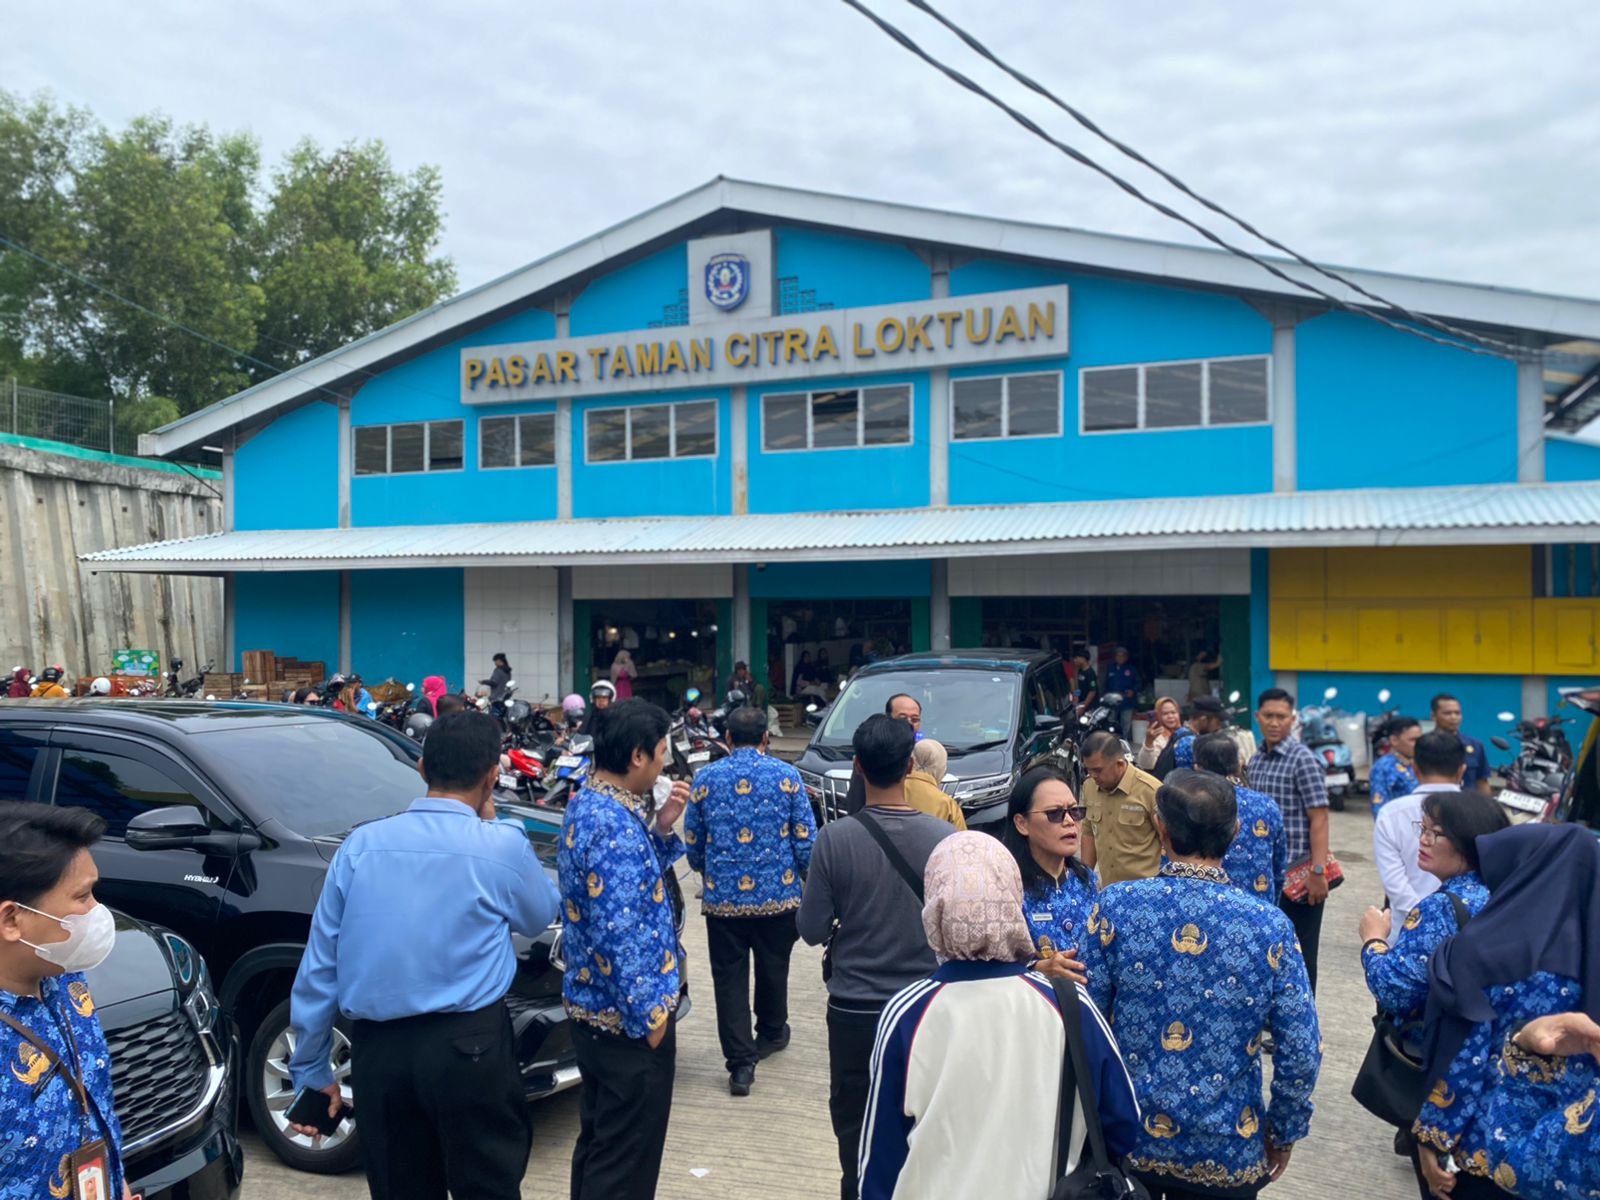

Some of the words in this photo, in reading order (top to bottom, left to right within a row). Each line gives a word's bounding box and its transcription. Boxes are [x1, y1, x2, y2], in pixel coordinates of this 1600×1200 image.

[465, 351, 578, 389] PASAR
[587, 337, 713, 379] TAMAN
[724, 324, 838, 367] CITRA
[853, 302, 1055, 357] LOKTUAN
